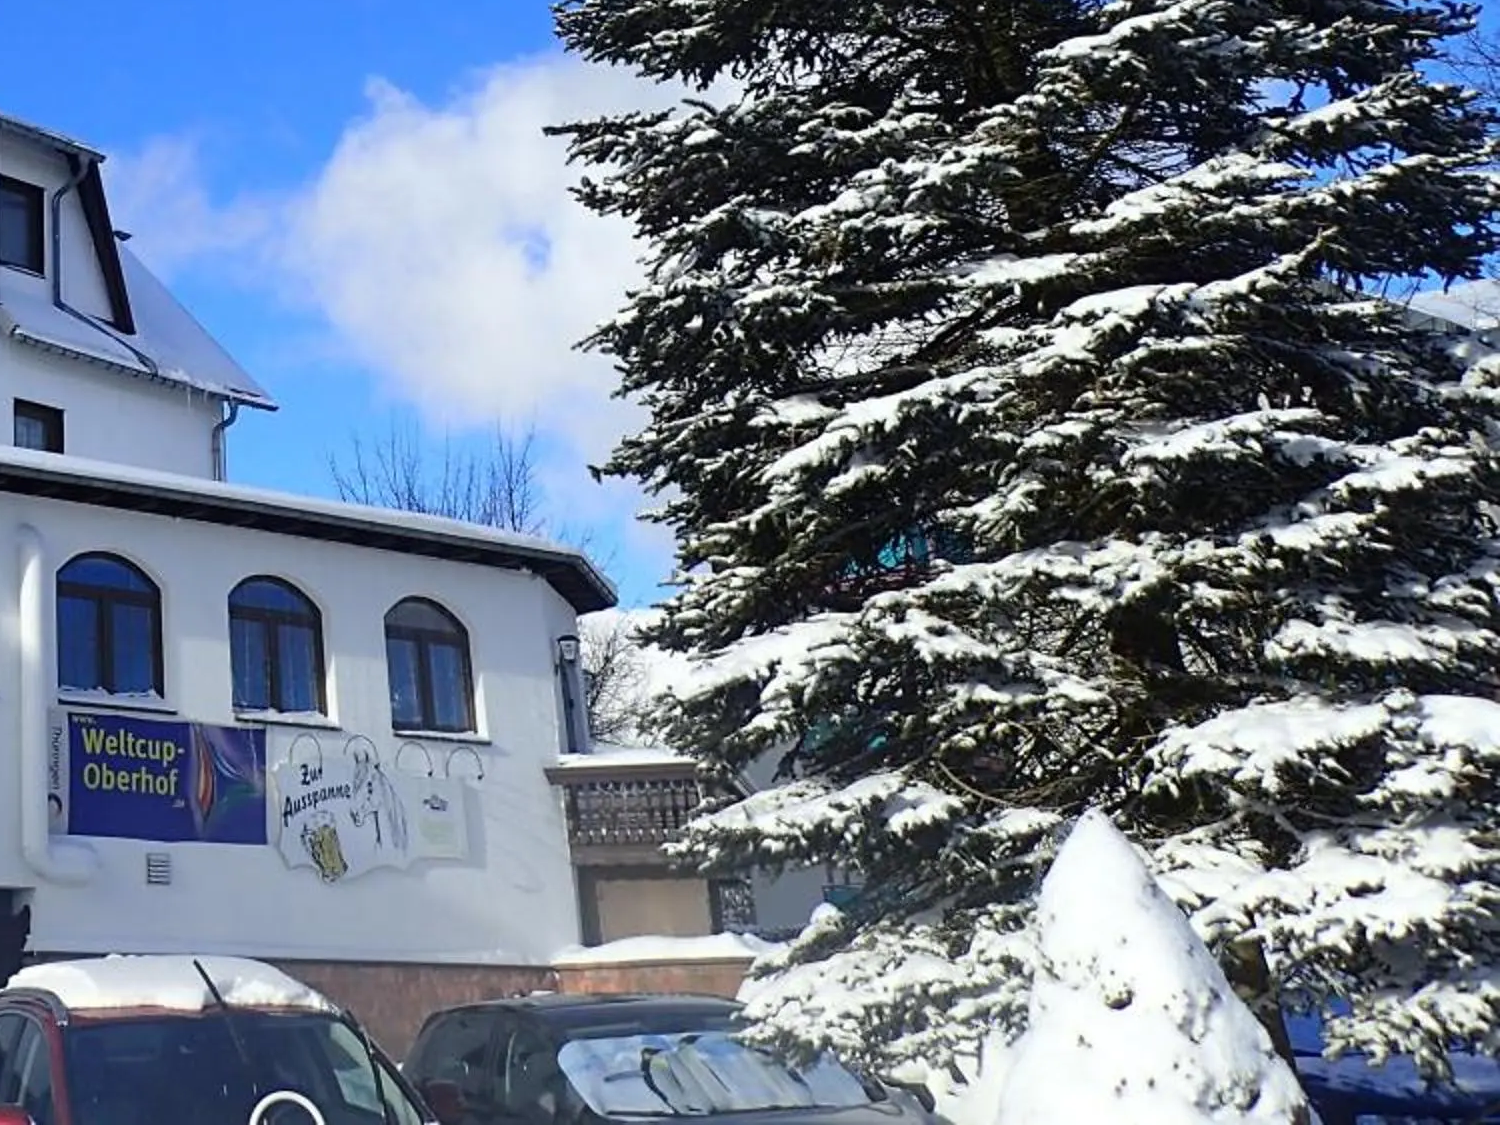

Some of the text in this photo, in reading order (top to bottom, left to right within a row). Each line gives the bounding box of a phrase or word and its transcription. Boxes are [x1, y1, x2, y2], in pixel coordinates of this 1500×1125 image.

[81, 728, 185, 768] Weltcup-
[83, 762, 179, 796] Oberhof
[300, 763, 323, 786] Zur
[283, 783, 351, 828] Ausspanne
